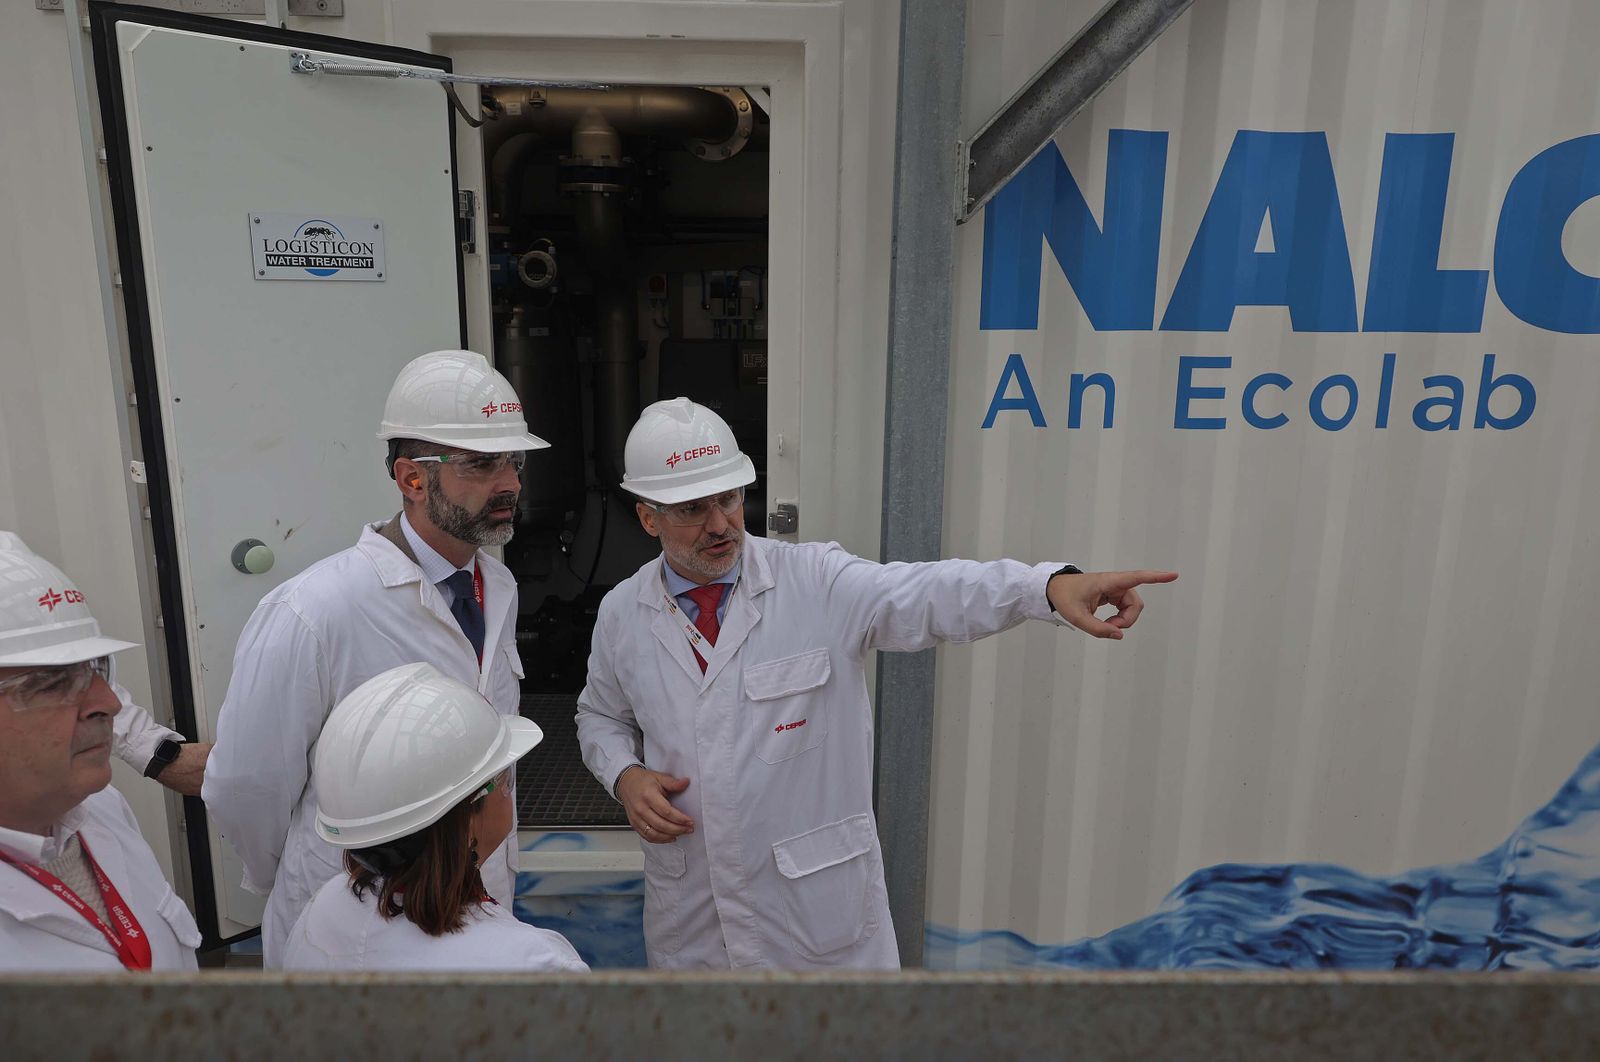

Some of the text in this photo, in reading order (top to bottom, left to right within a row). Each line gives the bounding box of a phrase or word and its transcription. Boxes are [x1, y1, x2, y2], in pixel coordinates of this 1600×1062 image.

[263, 238, 374, 255] LOGISTICON
[266, 255, 373, 268] WATER TREATMENT
[981, 352, 1536, 431] An Ecolab
[684, 444, 721, 461] CEPSA
[112, 905, 132, 930] CEPSA
